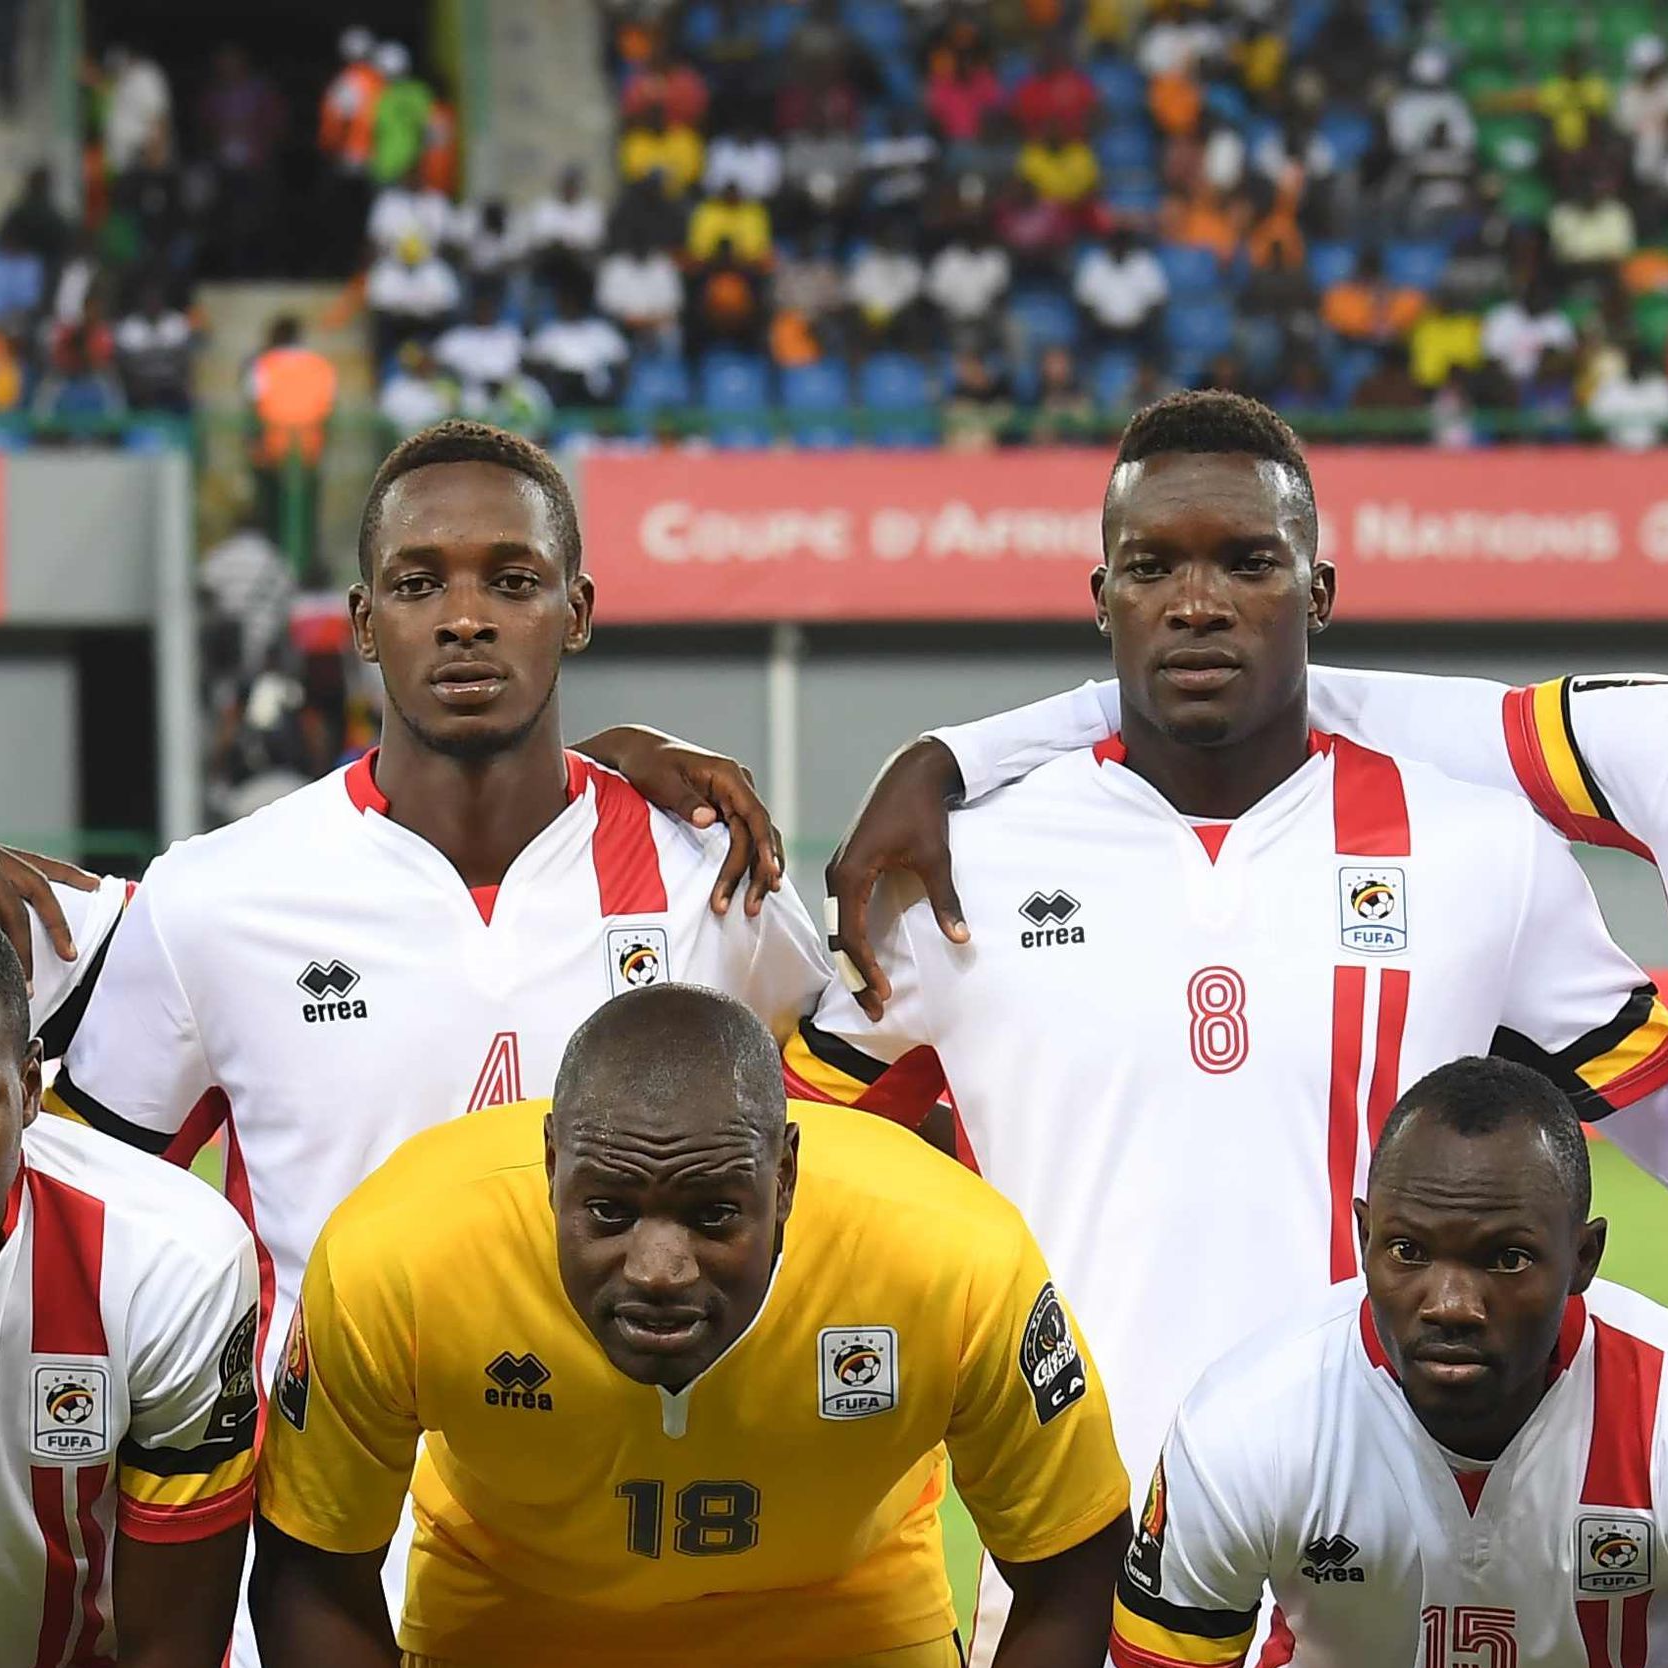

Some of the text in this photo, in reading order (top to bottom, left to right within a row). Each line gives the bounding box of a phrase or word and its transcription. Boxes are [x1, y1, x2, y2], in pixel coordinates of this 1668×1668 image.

[1020, 925, 1086, 949] errea
[1352, 930, 1395, 946] FUFA
[302, 999, 368, 1024] errea
[1186, 965, 1250, 1075] 8
[484, 1388, 554, 1412] errea
[835, 1396, 880, 1412] FUFA
[47, 1435, 92, 1449] FUFA
[615, 1478, 761, 1560] 18
[1591, 1575, 1638, 1588] FUFA
